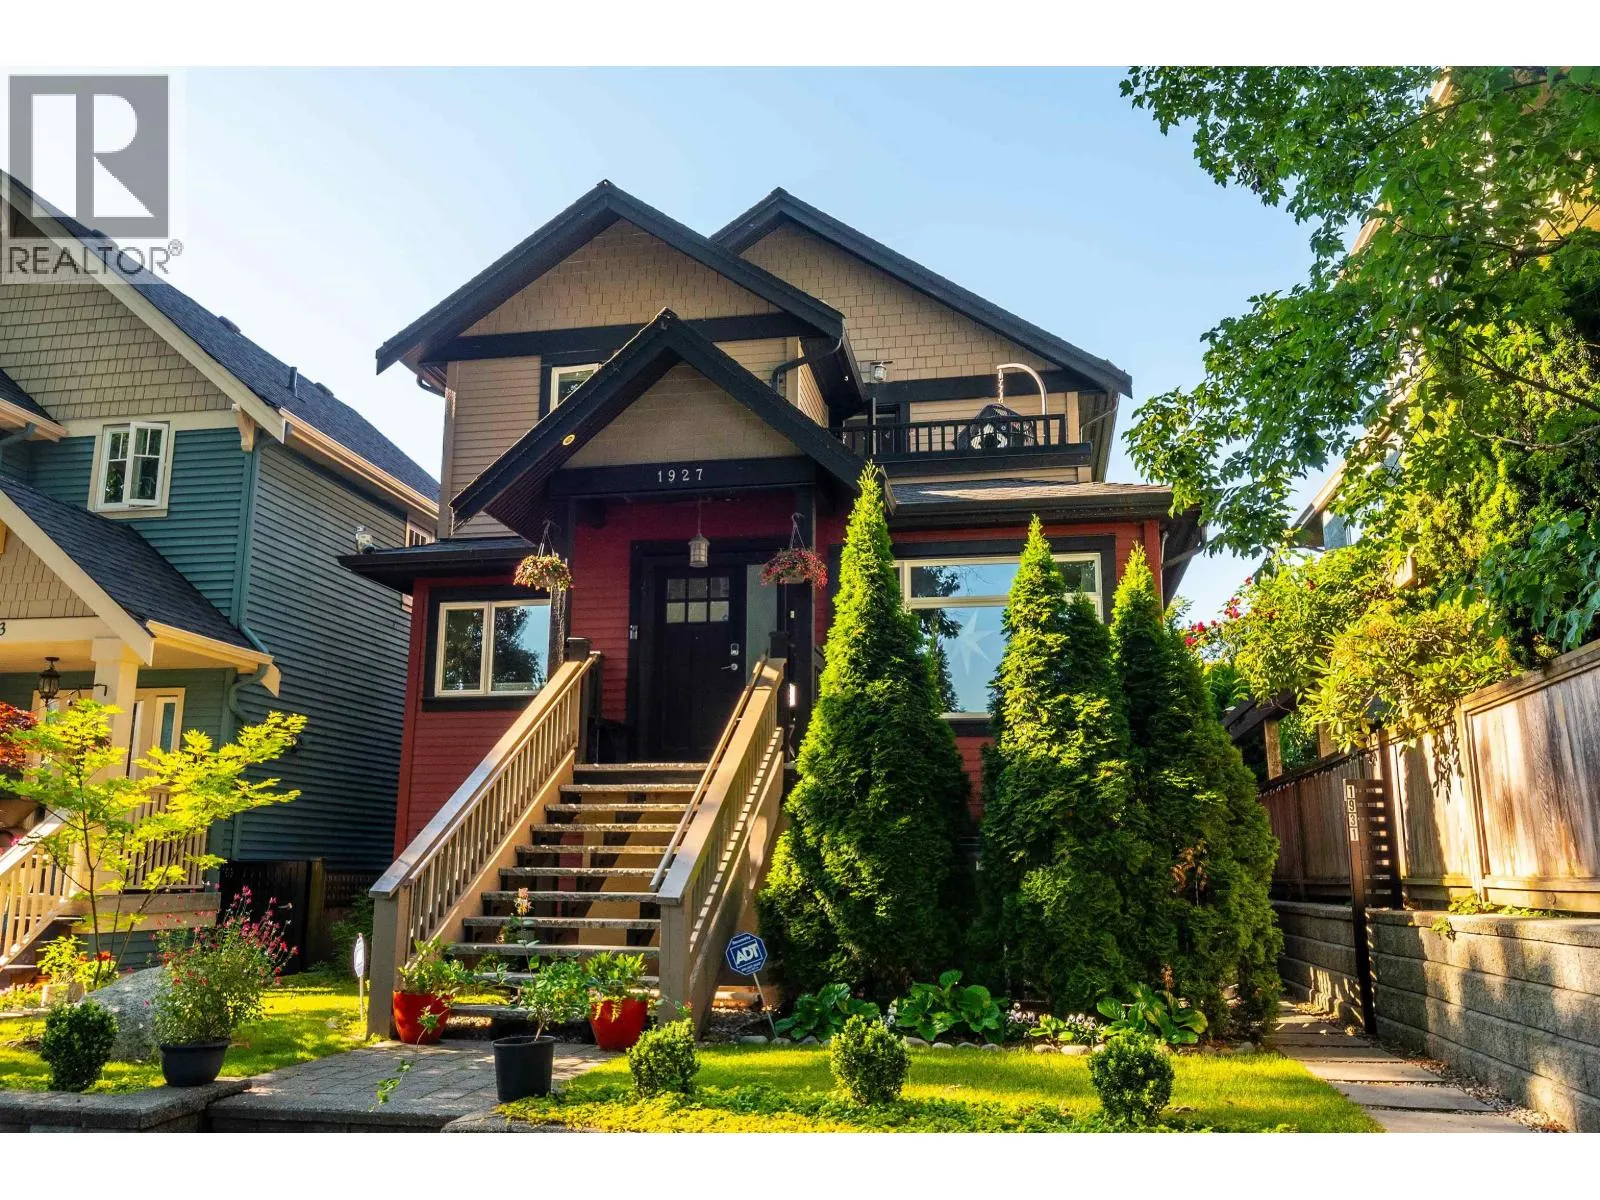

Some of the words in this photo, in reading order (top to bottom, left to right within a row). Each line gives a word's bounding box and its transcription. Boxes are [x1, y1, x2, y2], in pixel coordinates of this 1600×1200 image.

[657, 468, 703, 482] 1927
[1347, 786, 1358, 840] 1931
[736, 942, 759, 965] ADT
